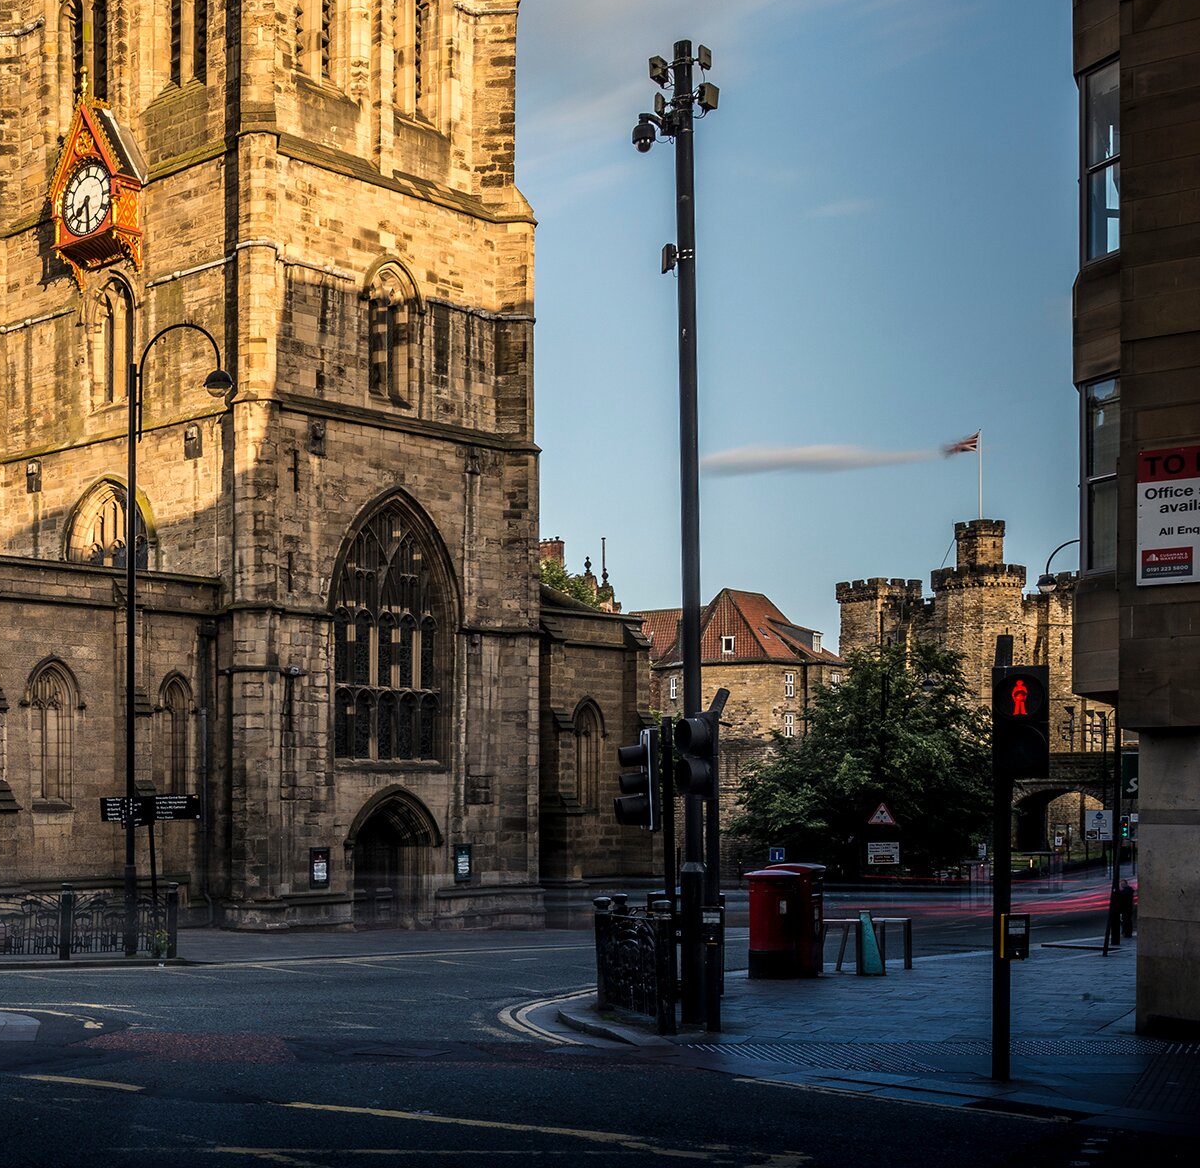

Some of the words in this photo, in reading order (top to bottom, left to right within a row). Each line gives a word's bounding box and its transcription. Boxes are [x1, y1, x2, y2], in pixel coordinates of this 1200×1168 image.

[1144, 454, 1185, 476] TO
[1145, 486, 1194, 500] Office
[1160, 499, 1200, 514] avail
[1159, 526, 1174, 536] All
[1178, 526, 1200, 535] Enq
